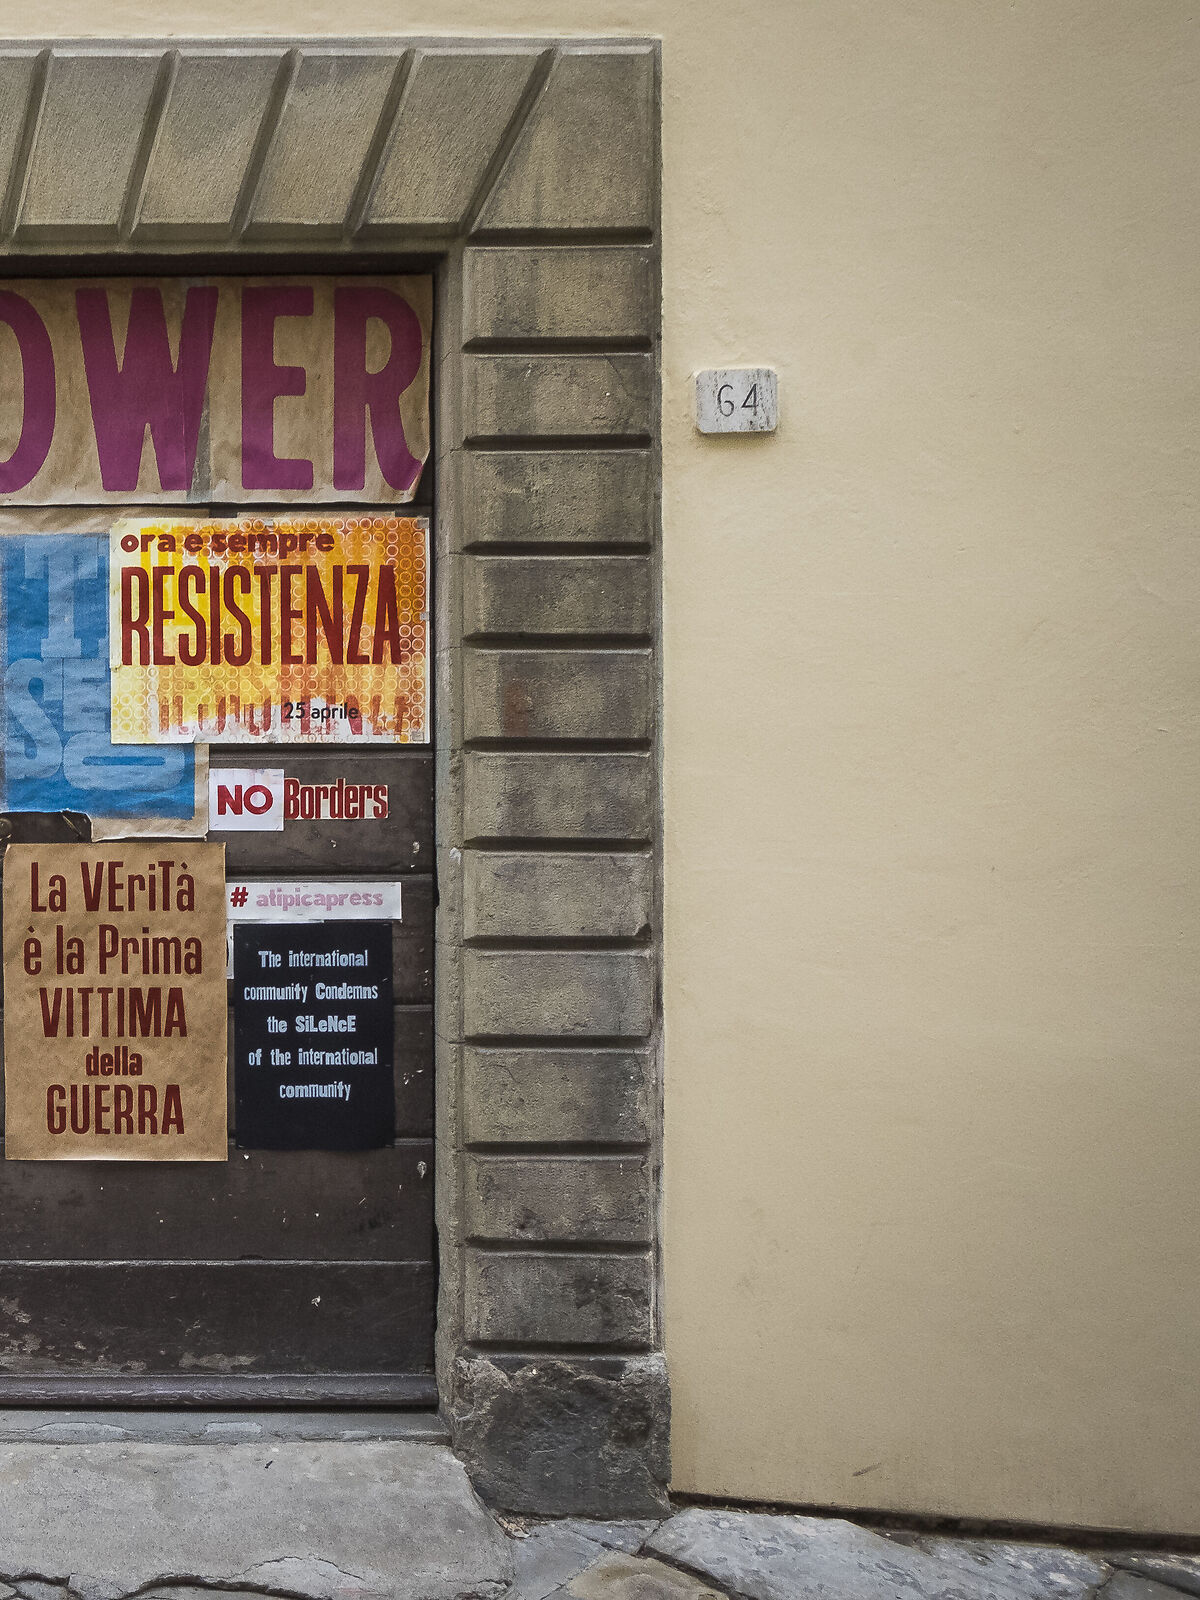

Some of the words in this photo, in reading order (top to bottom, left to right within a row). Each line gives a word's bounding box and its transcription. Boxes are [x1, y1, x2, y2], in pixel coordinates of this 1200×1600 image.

[717, 383, 759, 417] 64
[120, 533, 176, 553] ora
[184, 533, 205, 553] e
[213, 532, 336, 559] sempre
[121, 564, 402, 667] RESISTENZA
[284, 702, 306, 719] 25
[311, 702, 360, 722] aprile
[217, 784, 274, 815] NO
[284, 778, 389, 819] Borders
[31, 862, 67, 912] La
[80, 861, 195, 912] VEriTà
[256, 887, 384, 911] atipicapress
[23, 926, 41, 976] è
[56, 925, 84, 975] la
[100, 924, 203, 975] Prima
[258, 950, 282, 968] The
[288, 950, 368, 968] international
[244, 983, 308, 1002] community
[315, 982, 378, 1000] Condemns
[39, 987, 187, 1038] VITTIMA
[267, 1016, 287, 1033] the
[86, 1046, 143, 1077] della
[248, 1049, 262, 1065] of
[270, 1049, 291, 1065] the
[298, 1048, 378, 1065] international
[279, 1081, 351, 1101] community
[46, 1084, 185, 1135] GUERRA
